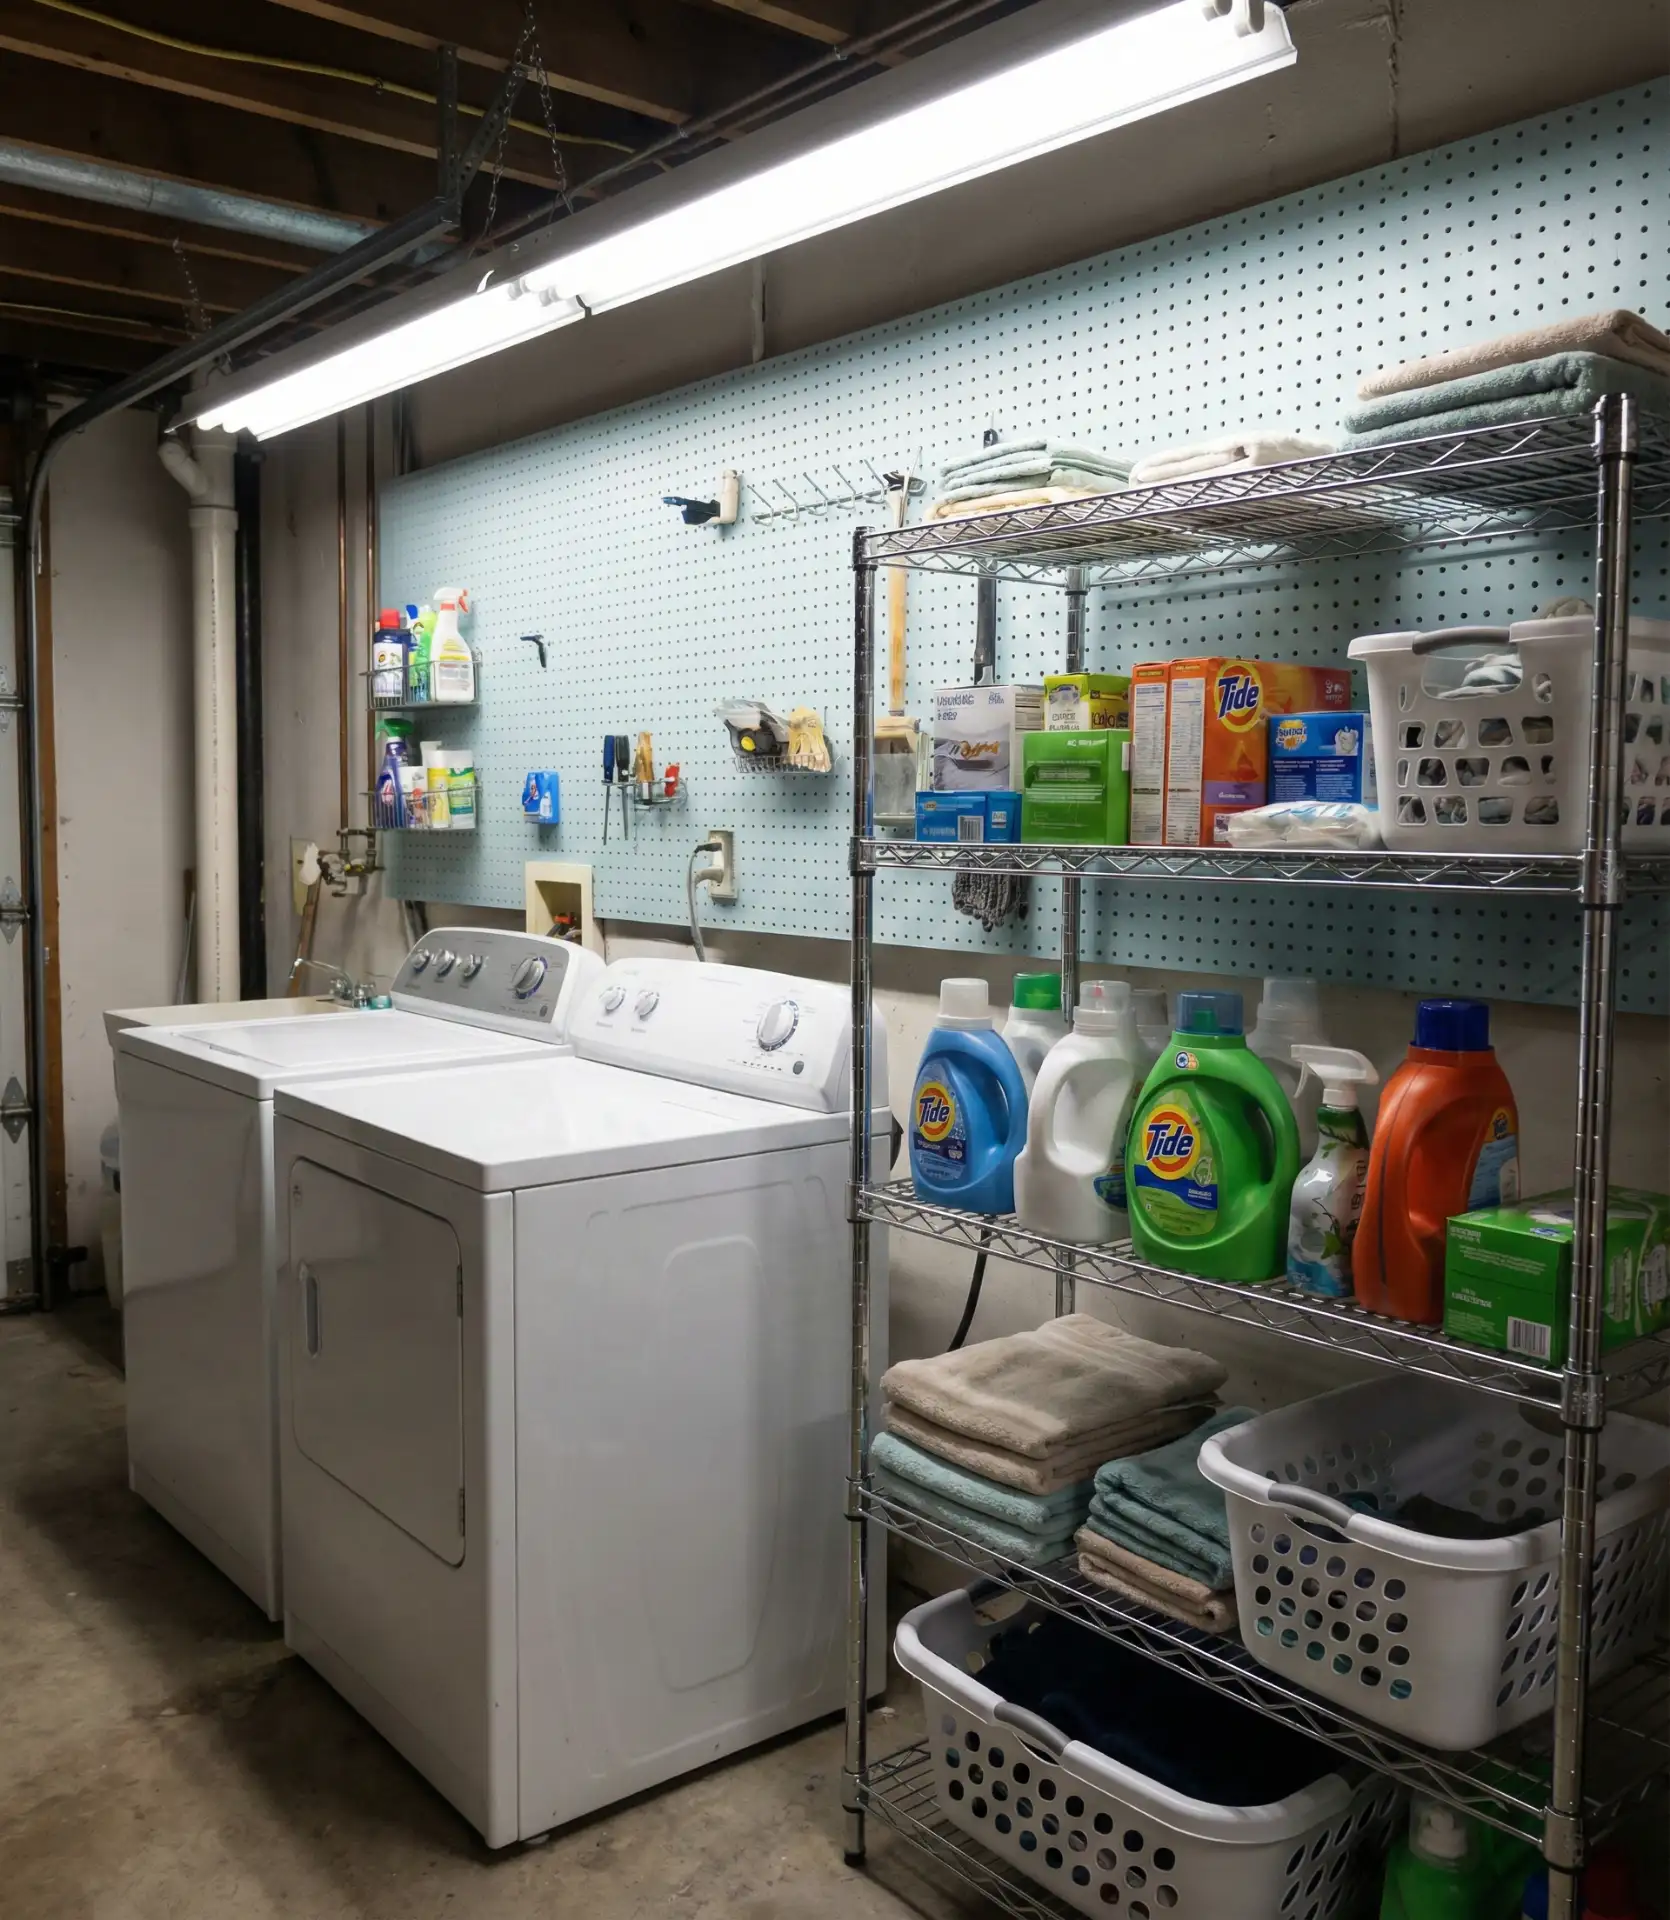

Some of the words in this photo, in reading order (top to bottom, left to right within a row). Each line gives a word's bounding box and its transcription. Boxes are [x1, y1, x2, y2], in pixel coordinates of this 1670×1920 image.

[1217, 675, 1259, 719] Tide
[919, 1096, 950, 1127] Tide
[1146, 1124, 1194, 1161] Tide
